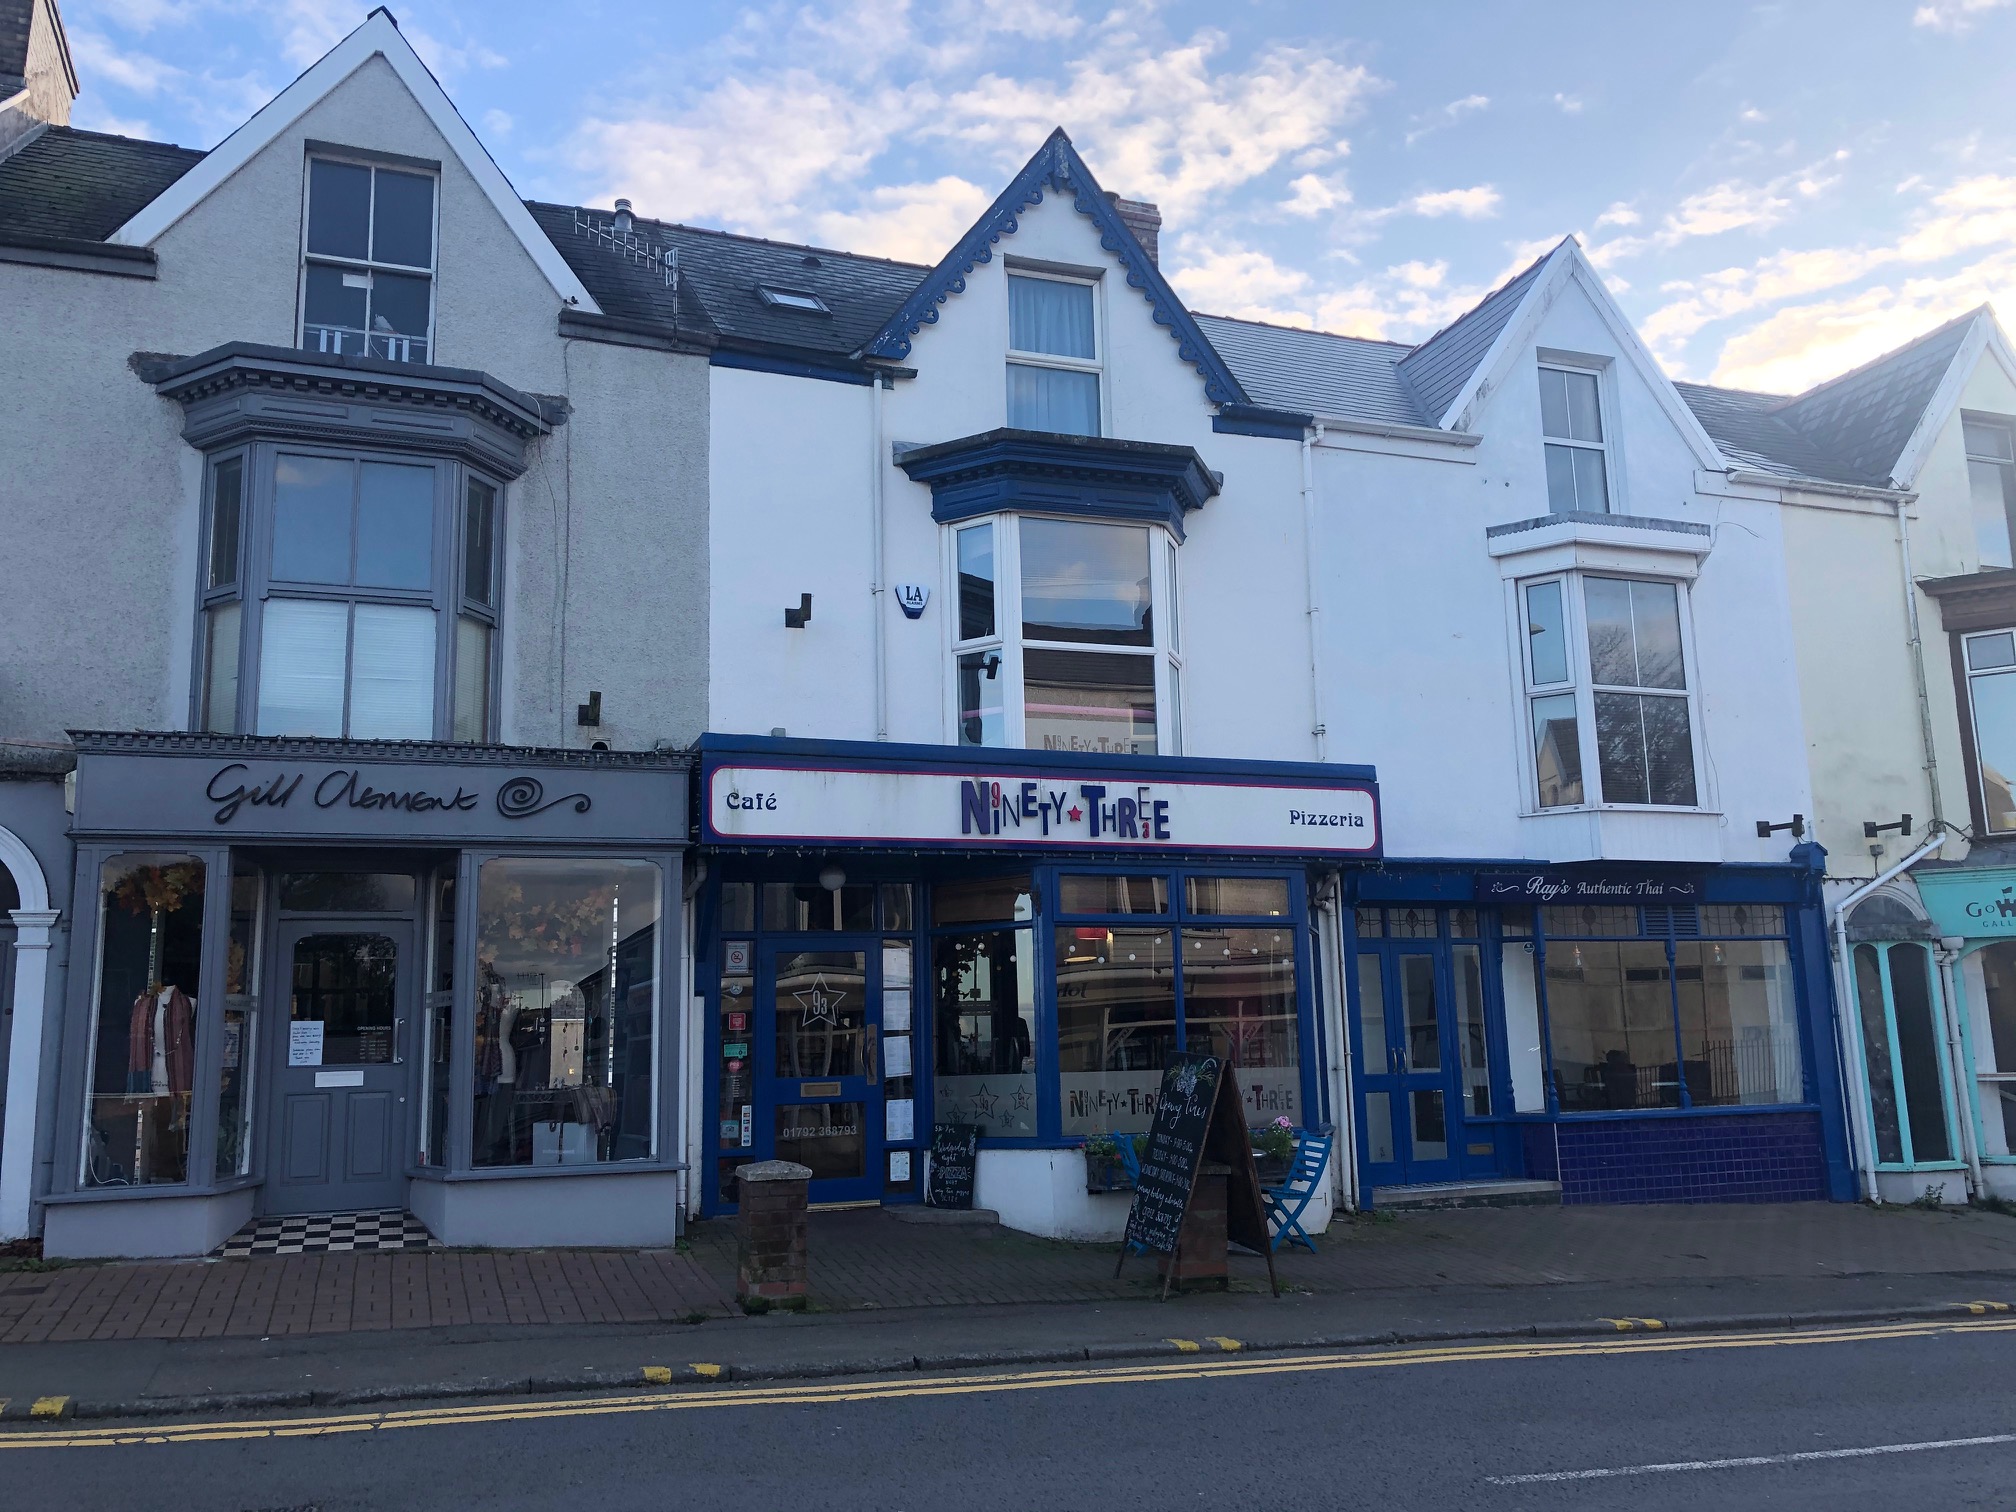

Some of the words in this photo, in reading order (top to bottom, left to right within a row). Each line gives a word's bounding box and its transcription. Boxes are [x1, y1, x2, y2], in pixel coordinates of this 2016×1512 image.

[905, 585, 923, 601] LA
[205, 763, 304, 824] Gill
[314, 769, 480, 813] Clement
[726, 791, 777, 811] Café
[960, 780, 1067, 836] NINETY
[1080, 785, 1171, 840] THREE
[1289, 809, 1364, 828] Pizzeria
[1525, 875, 1572, 901] Ray's
[1576, 878, 1632, 895] Authentic
[1635, 879, 1664, 895] Thai
[812, 989, 828, 1016] 93
[1069, 1089, 1120, 1118] NINETY
[1251, 1083, 1294, 1112] THREE
[783, 1126, 816, 1138] 01792
[818, 1124, 857, 1137] 368793
